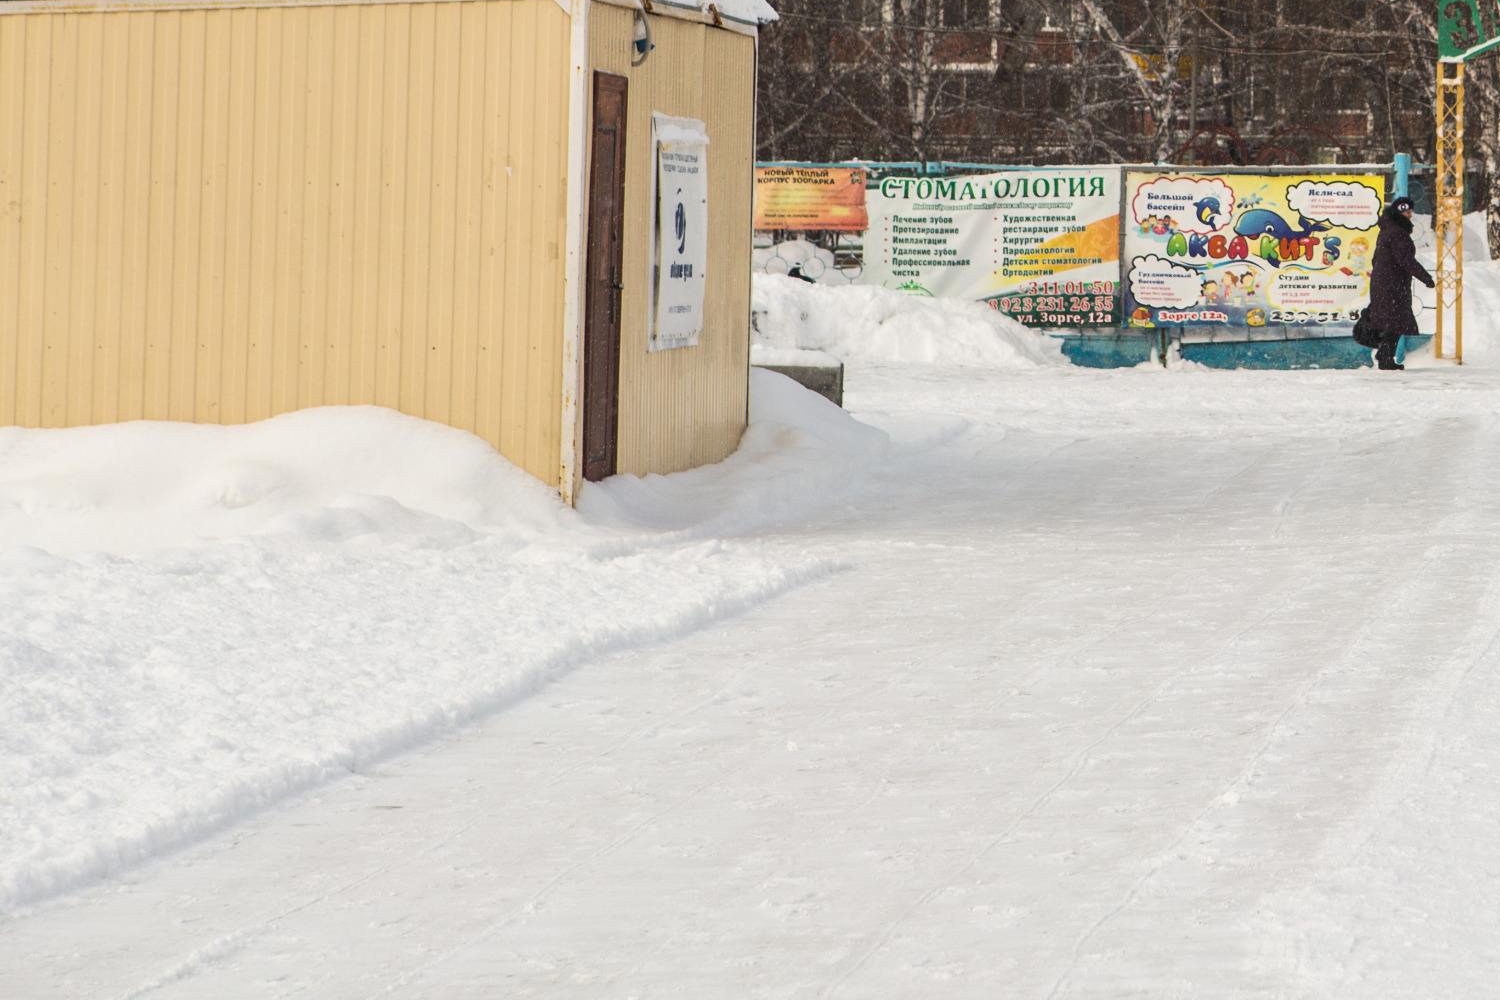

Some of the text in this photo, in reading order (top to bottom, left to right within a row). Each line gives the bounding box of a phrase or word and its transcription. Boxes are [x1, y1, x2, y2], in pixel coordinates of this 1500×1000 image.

[764, 168, 794, 177] НОВЫЙ
[881, 176, 1105, 200] СТОМАТОЛОГИЯ
[1308, 188, 1354, 197] Ясли-сад
[1147, 192, 1194, 201] Большой
[893, 215, 953, 225] Лечение зубов
[1002, 215, 1077, 224] Художественная
[892, 225, 960, 235] Протезирование
[1002, 225, 1086, 234] реставрация зубов
[892, 236, 947, 245] Имплантация
[1002, 236, 1045, 245] Хирургия
[1166, 231, 1250, 260] АКВА
[892, 247, 958, 256] Удаление зубов
[1002, 247, 1075, 256] Пародонтология
[892, 258, 971, 267] Профессиональная
[1002, 257, 1039, 266] Детская
[1002, 268, 1054, 277] Ортодонтия
[1138, 271, 1192, 279] Грудничковый
[1017, 311, 1113, 325] ул. Зорге, 12а
[1159, 311, 1228, 322] Зорге 12а,
